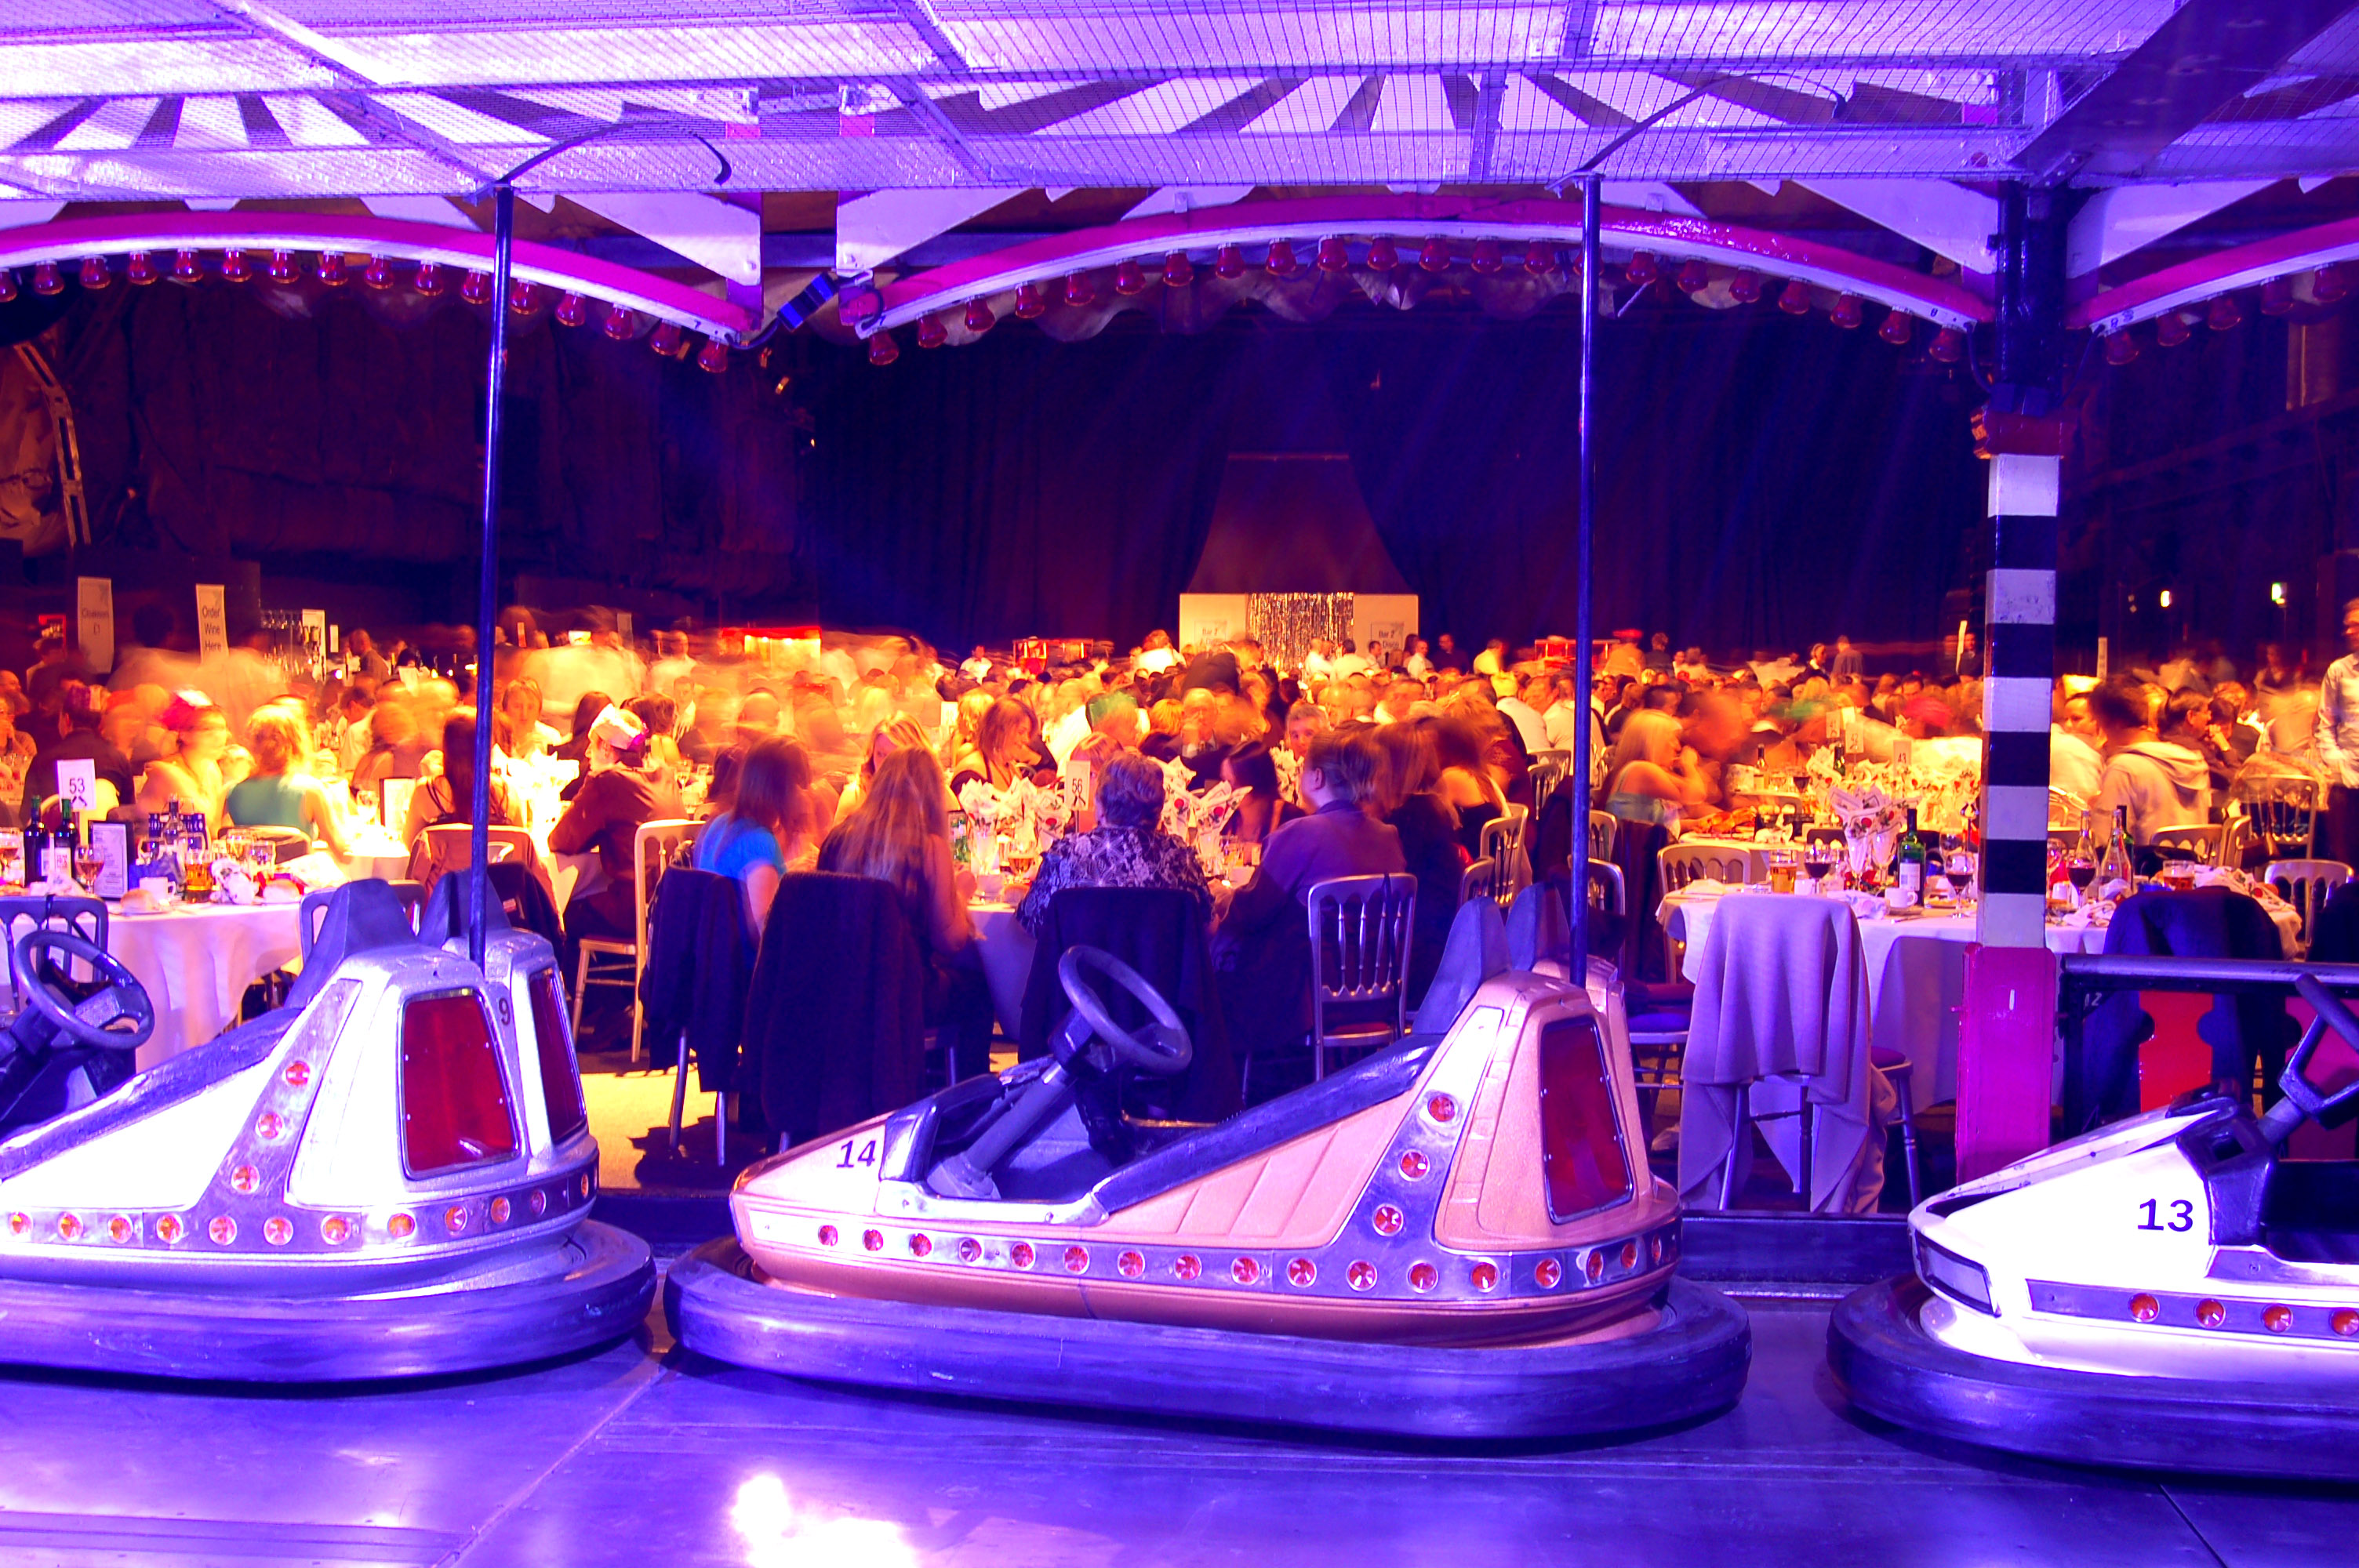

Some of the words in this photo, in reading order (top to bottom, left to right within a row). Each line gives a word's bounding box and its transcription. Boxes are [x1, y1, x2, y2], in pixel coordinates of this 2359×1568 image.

[202, 605, 221, 619] Order
[205, 623, 221, 636] Wine
[205, 640, 223, 652] Here
[69, 778, 85, 795] 53
[1071, 778, 1083, 794] 56
[498, 997, 511, 1026] 9
[836, 1140, 877, 1168] 14
[2137, 1198, 2194, 1232] 13
